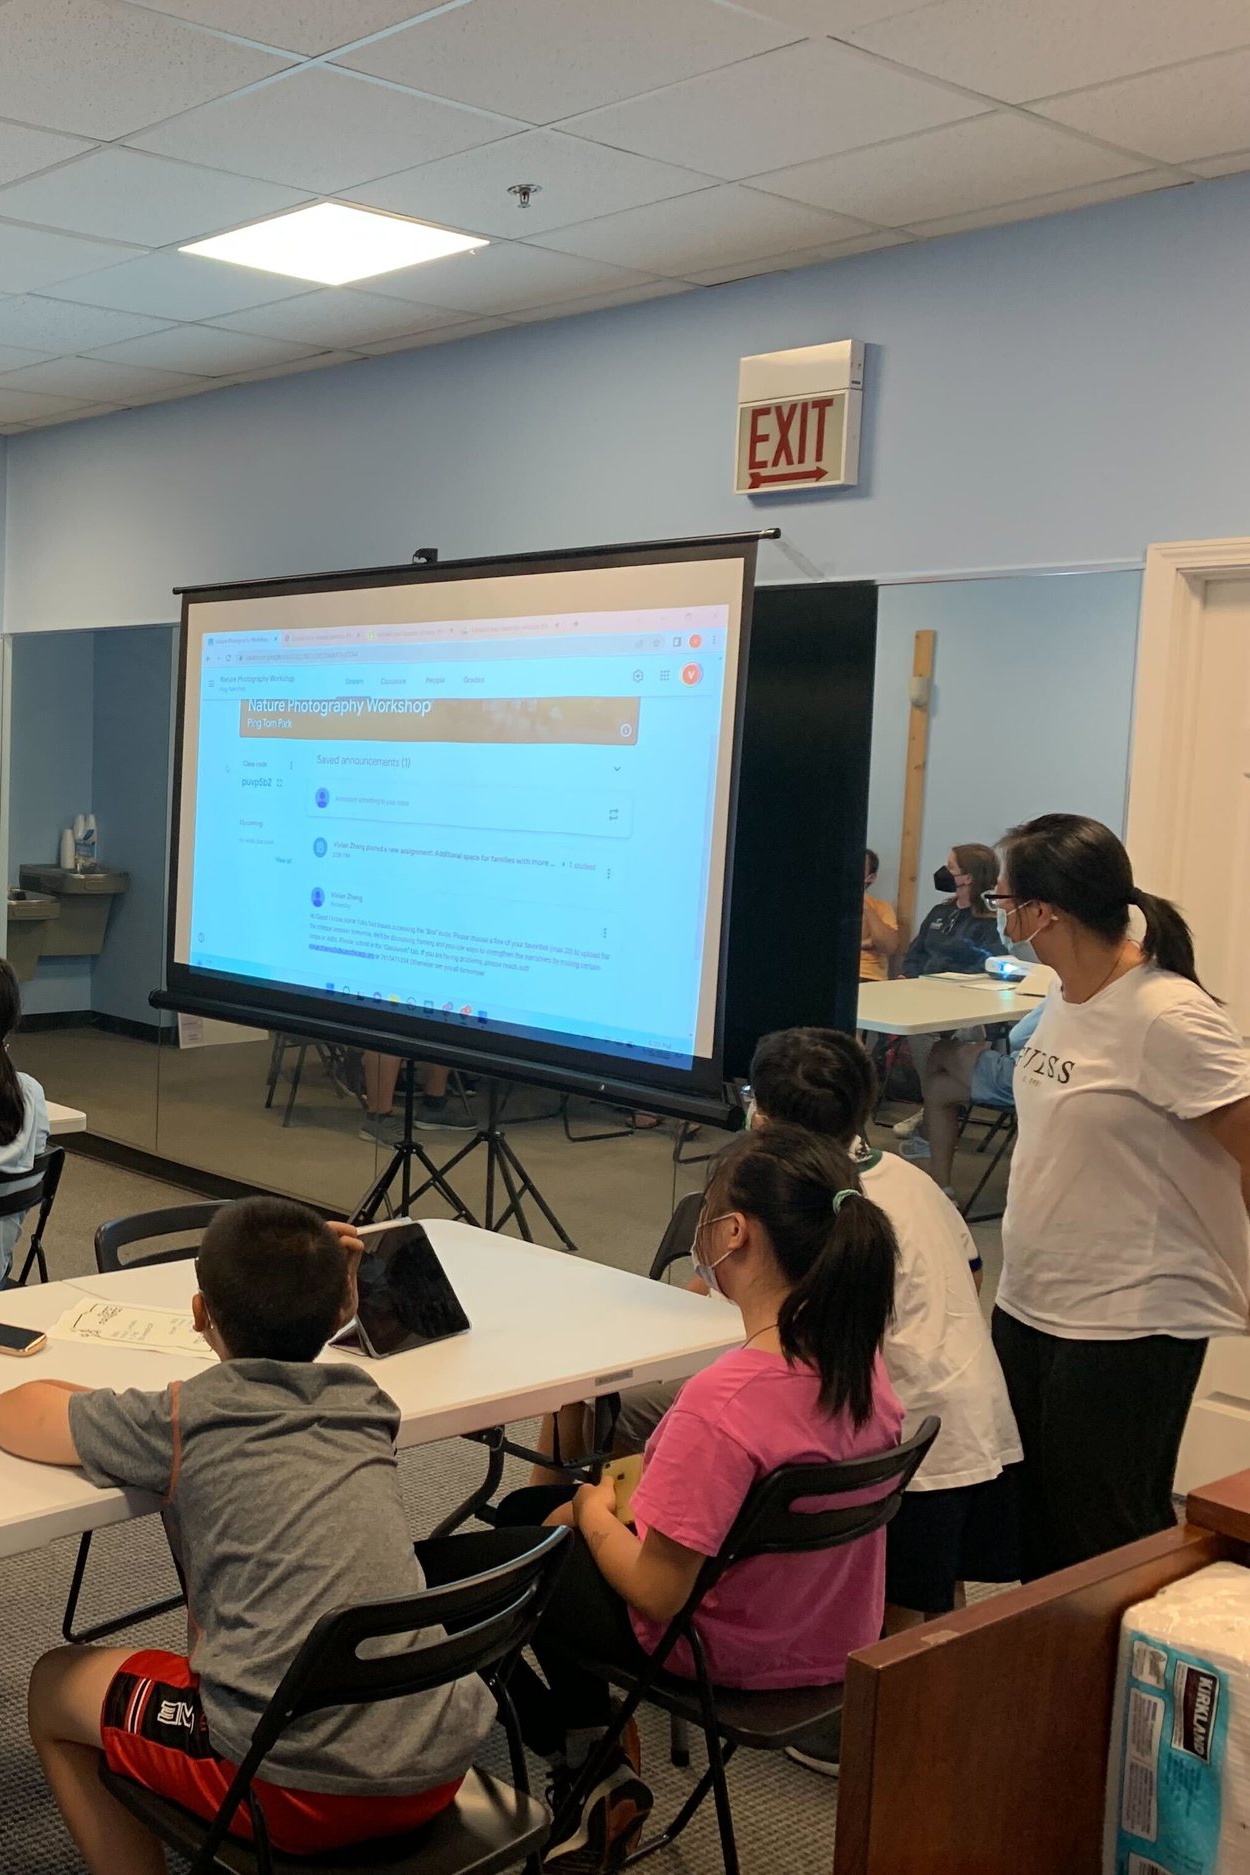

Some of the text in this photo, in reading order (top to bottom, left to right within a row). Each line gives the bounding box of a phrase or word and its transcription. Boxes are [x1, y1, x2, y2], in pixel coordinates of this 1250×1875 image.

[748, 399, 834, 470] EXIT
[237, 675, 269, 685] Photography
[269, 675, 294, 684] Workshop
[425, 677, 445, 685] People
[248, 699, 432, 717] Nature Photography Workshop
[247, 718, 293, 730] Ping Tom Park
[317, 755, 411, 769] Saved announcements (1)
[241, 777, 272, 788] puvp5b2
[333, 841, 348, 849] Vivian
[350, 842, 365, 852] Zhang
[435, 850, 462, 859] Additional
[463, 852, 479, 862] space
[491, 855, 515, 864] families
[516, 857, 530, 865] with
[531, 858, 548, 867] more
[1193, 1676, 1214, 1756] KIRKLAND
